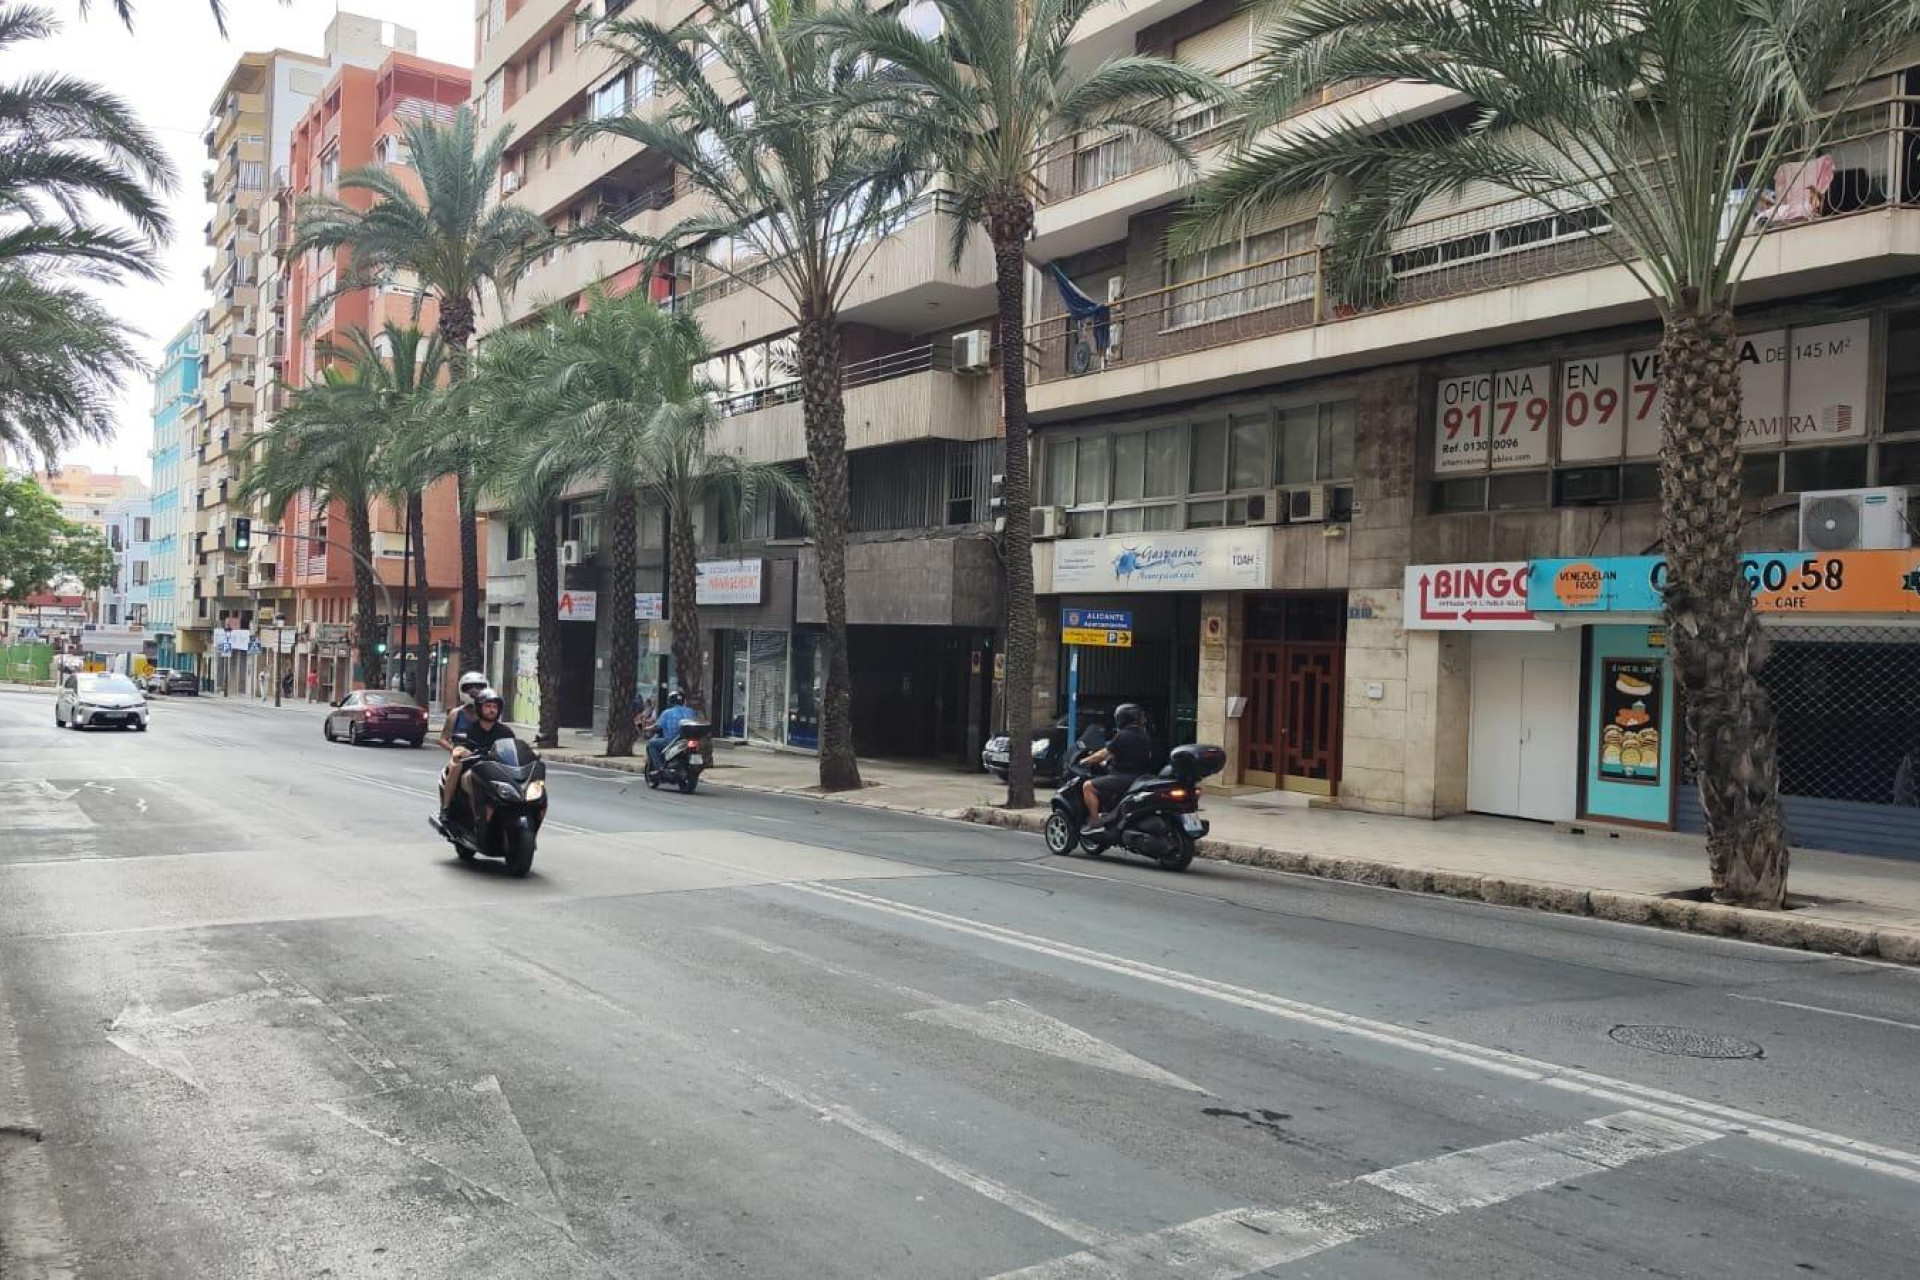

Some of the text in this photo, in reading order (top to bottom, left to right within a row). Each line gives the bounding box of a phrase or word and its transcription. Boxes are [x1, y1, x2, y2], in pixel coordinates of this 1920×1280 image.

[1444, 373, 1534, 405] OFICINA
[1567, 362, 1599, 389] EN
[1766, 346, 1787, 363] DE
[1795, 342, 1823, 361] 145
[1560, 571, 1617, 581] VENEZUELAN
[1575, 581, 1599, 590] FOOD
[1086, 612, 1125, 621] ALICANTE
